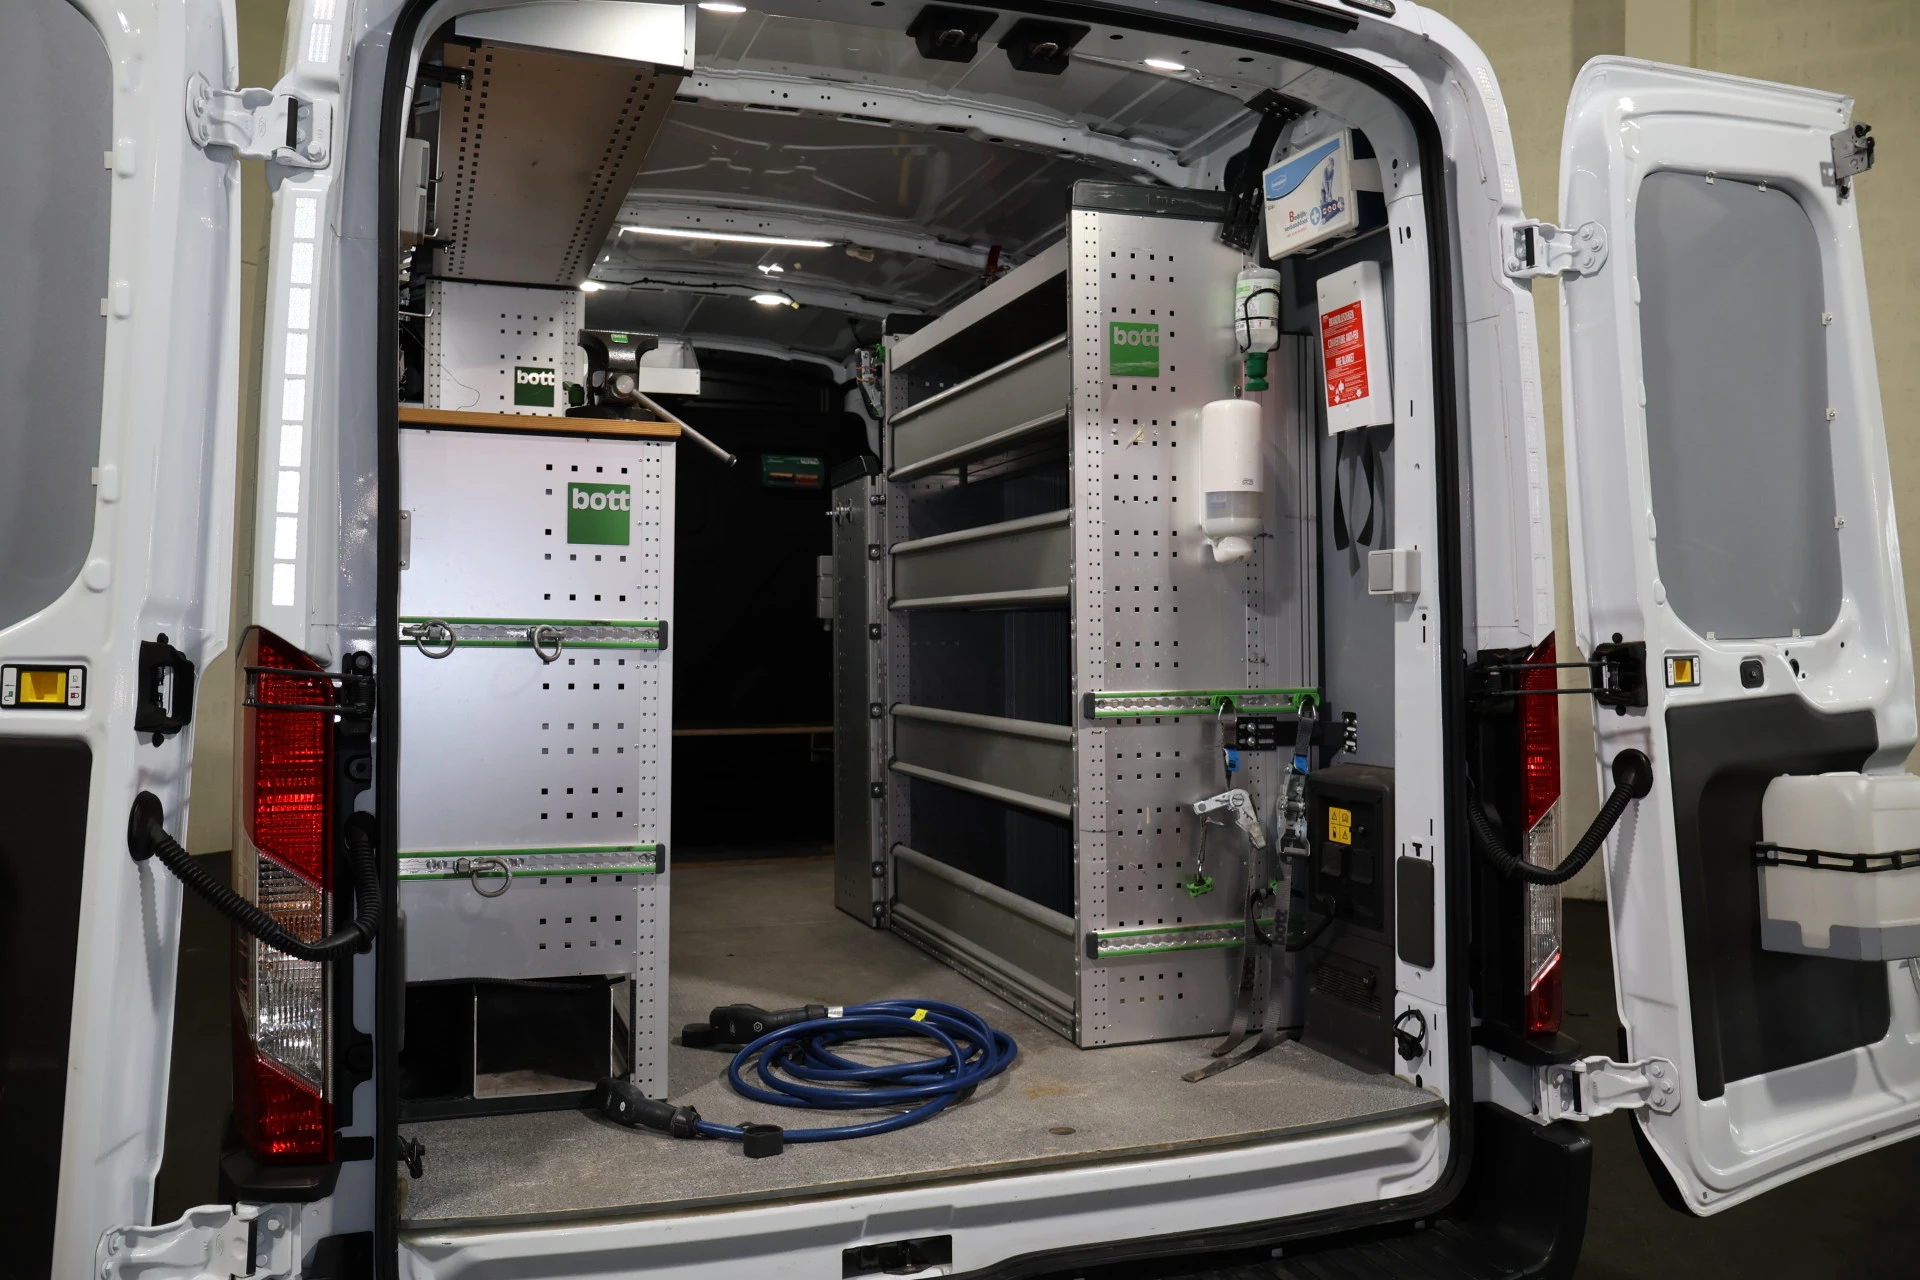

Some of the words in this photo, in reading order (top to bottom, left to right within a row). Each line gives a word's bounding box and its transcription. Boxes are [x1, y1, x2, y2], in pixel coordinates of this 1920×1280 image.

[1113, 326, 1160, 347] bott
[517, 370, 555, 386] bott
[572, 488, 630, 511] bott
